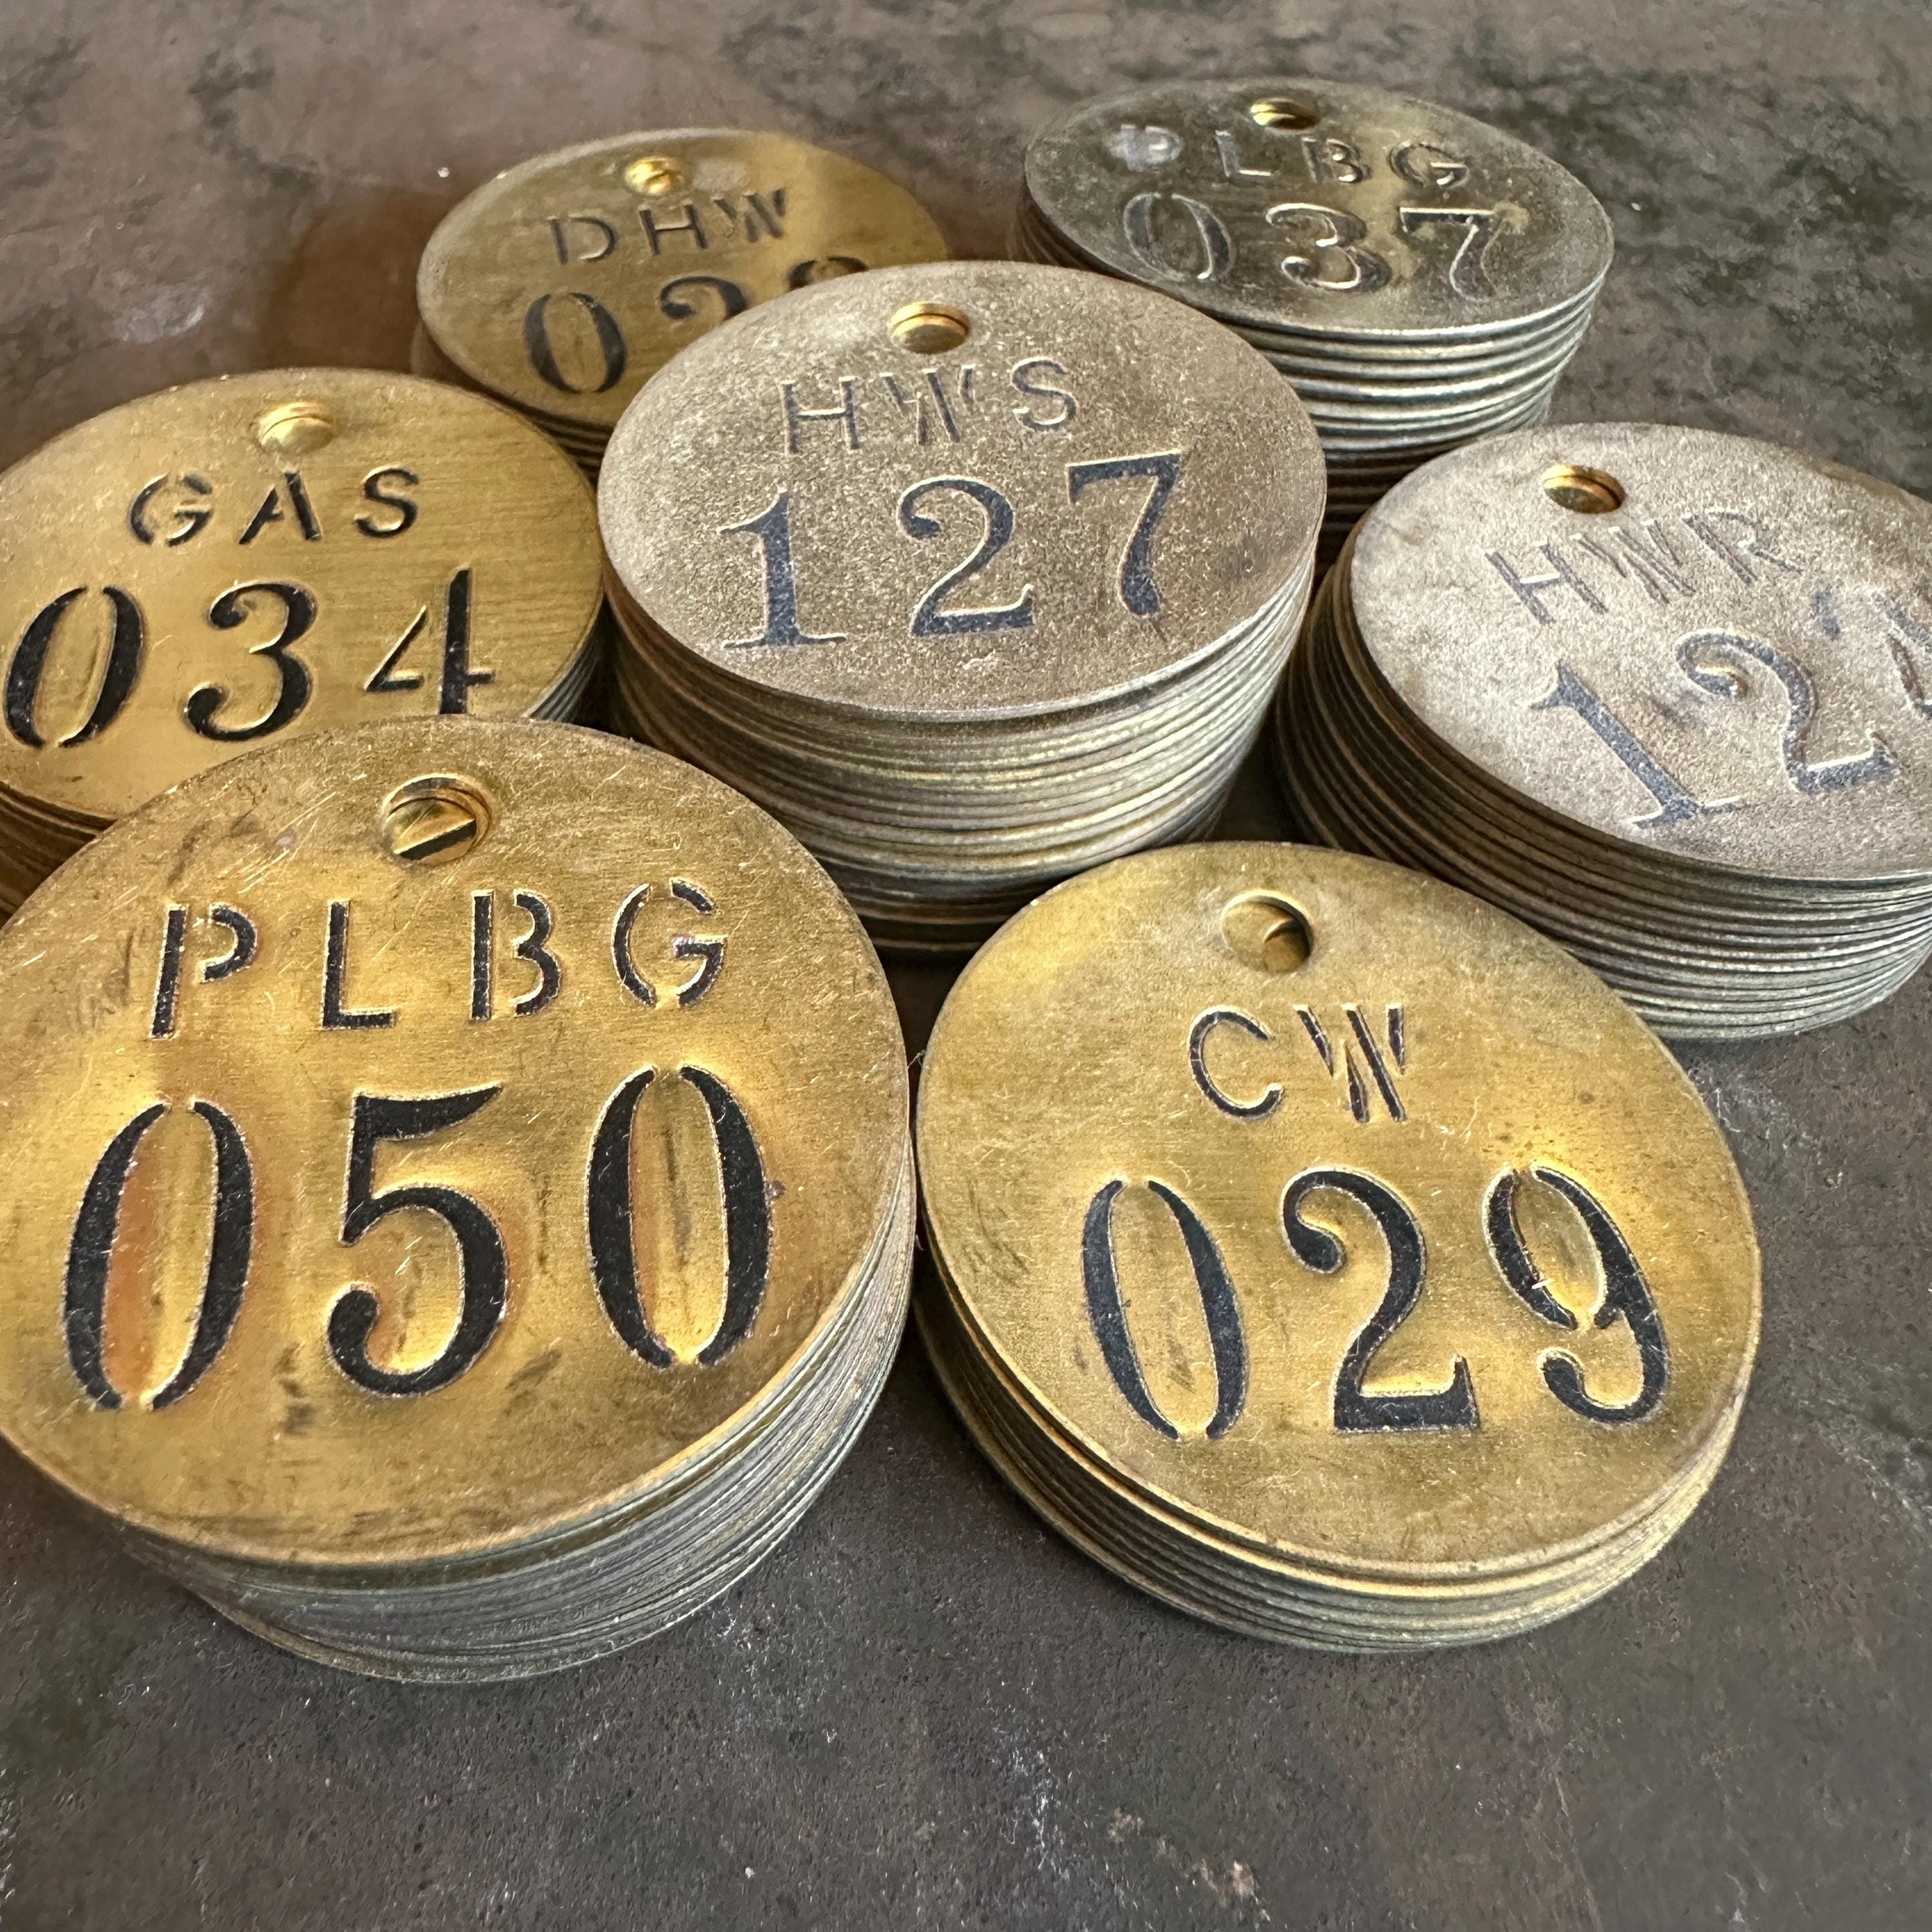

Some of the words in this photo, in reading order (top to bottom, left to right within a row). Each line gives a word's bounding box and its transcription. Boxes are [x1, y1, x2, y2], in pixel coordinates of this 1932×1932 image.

[1119, 123, 1471, 189] PLBG
[547, 187, 788, 265] DHW
[1122, 193, 1499, 303] 037
[781, 355, 1078, 455] HWS
[129, 465, 421, 547] GAS
[716, 448, 1182, 648] 127
[1484, 508, 1802, 624] HWR
[3, 564, 497, 750] 034
[149, 876, 728, 1040] PLBG
[1187, 1001, 1406, 1123] CW
[62, 1063, 773, 1412] 050
[1081, 1162, 1670, 1439] 029
